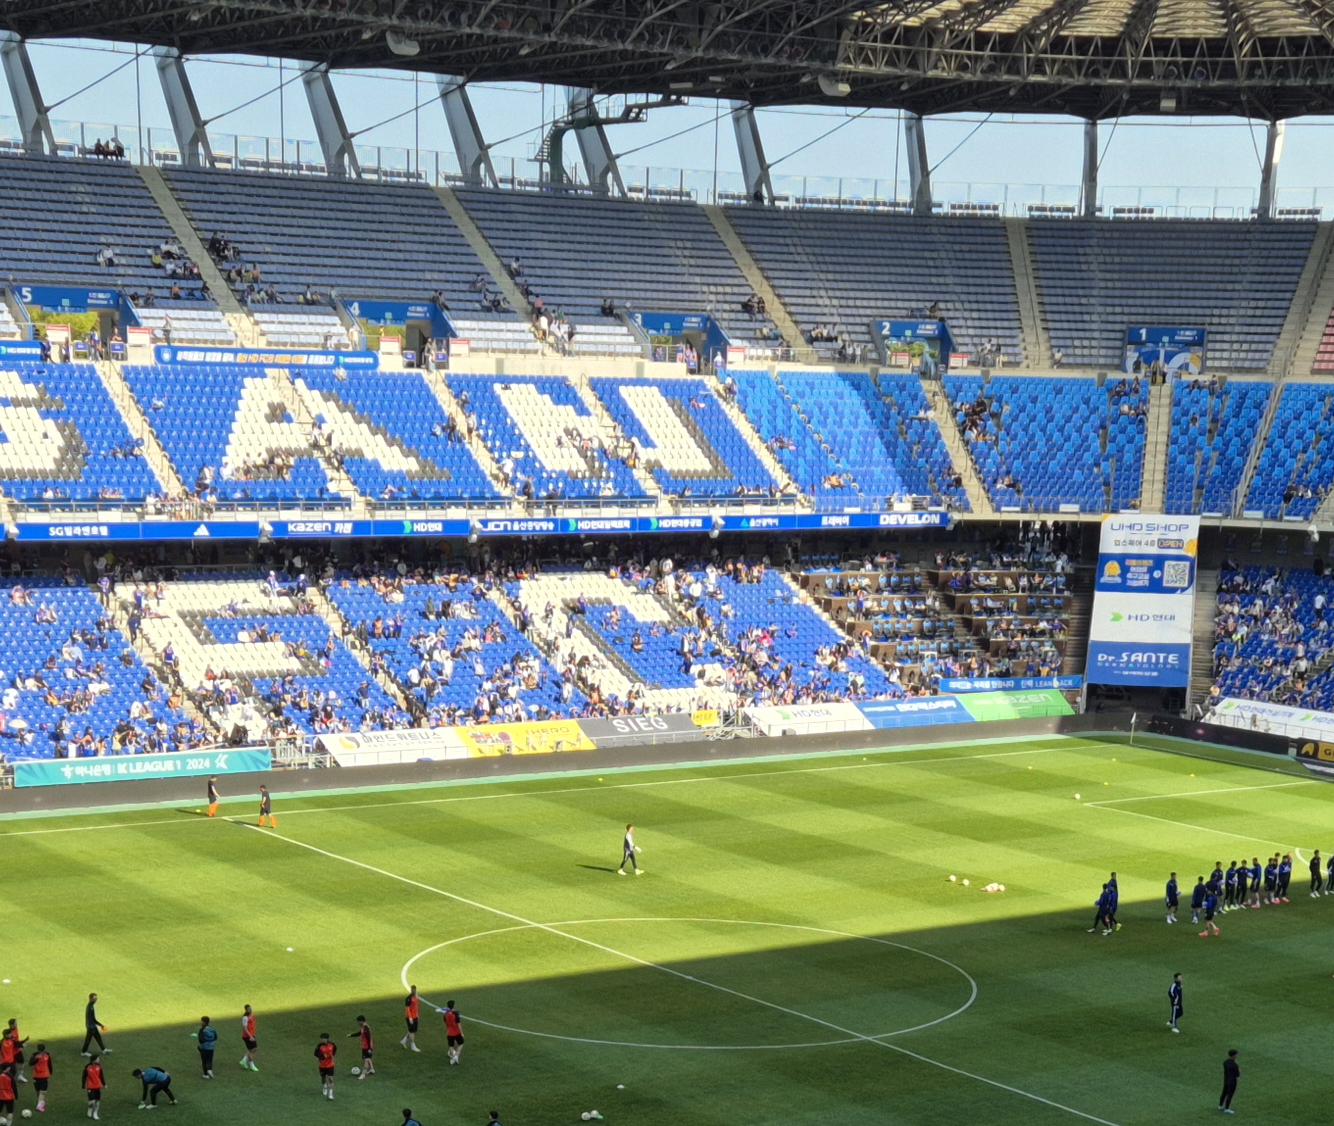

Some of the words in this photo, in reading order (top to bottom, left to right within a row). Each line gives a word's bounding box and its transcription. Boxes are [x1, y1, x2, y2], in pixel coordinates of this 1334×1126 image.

[21, 286, 33, 303] 5
[351, 302, 361, 317] 4
[881, 322, 891, 335] 2
[1139, 327, 1147, 341] 1
[879, 513, 940, 525] DEVELON
[1110, 522, 1144, 532] UHD
[1146, 522, 1190, 533] SHOP
[1157, 539, 1183, 549] OPEN
[1127, 613, 1150, 622] HD
[612, 715, 670, 733] SIEG
[128, 760, 175, 774] LEAGUE
[185, 758, 211, 770] 2024
